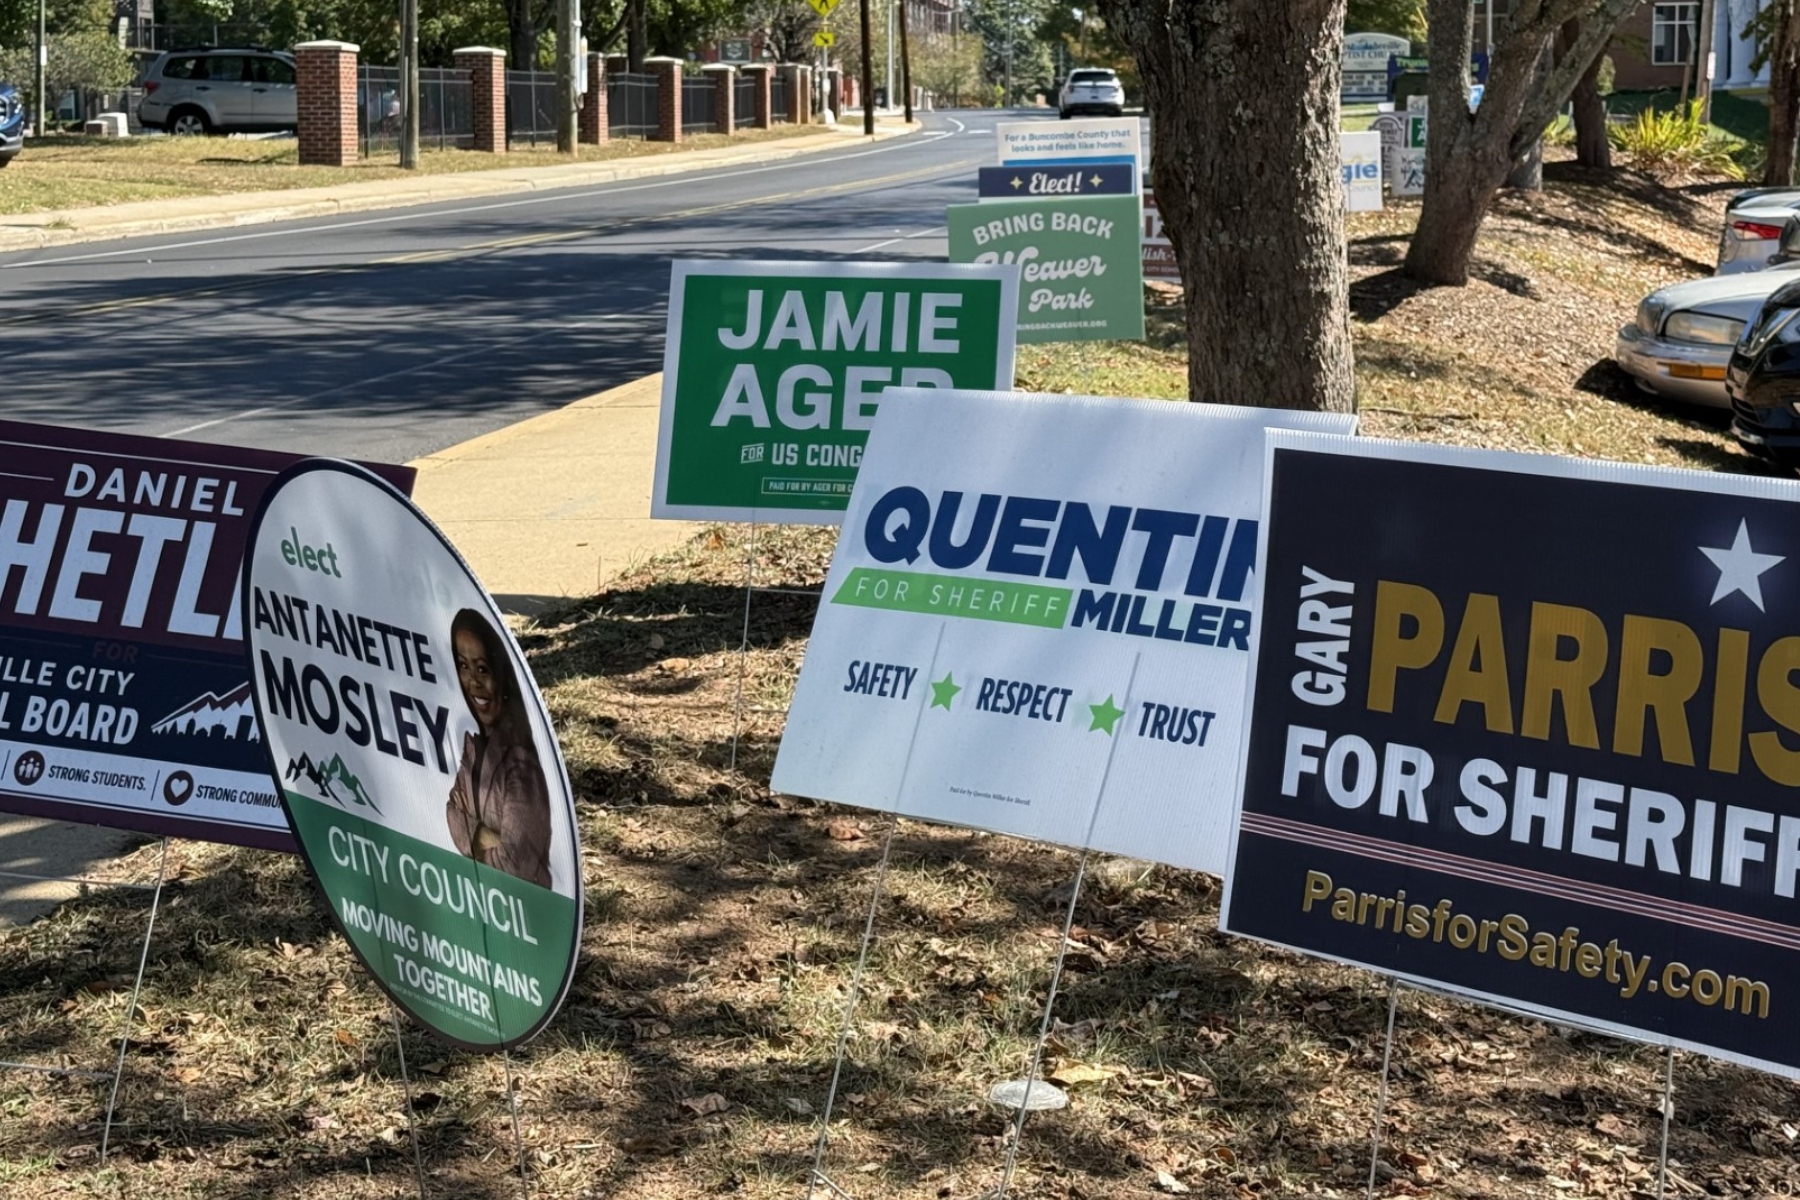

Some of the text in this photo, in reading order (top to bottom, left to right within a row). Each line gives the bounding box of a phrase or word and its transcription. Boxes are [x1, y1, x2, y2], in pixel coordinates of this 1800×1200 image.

[1005, 133, 1019, 142] For
[1028, 132, 1075, 141] Buncombe
[1077, 130, 1109, 140] County
[1111, 129, 1131, 138] that
[1012, 140, 1126, 152] looks and feels like home.
[1028, 171, 1083, 194] Elect!
[972, 212, 1114, 246] BRING BACK
[718, 289, 963, 353] JAMIE
[1028, 287, 1095, 313] Park
[741, 445, 764, 461] FOR
[771, 443, 799, 465] US
[64, 462, 245, 517] DANIEL
[786, 482, 800, 491] FOR
[801, 482, 811, 491] BY
[813, 483, 831, 492] AGER
[833, 483, 846, 492] FOR
[0, 499, 244, 641] HETL
[280, 526, 342, 578] elect
[855, 576, 1062, 619] FOR SHERIFF
[1070, 588, 1252, 651] MILLER
[91, 642, 139, 663] FOR
[254, 585, 438, 685] ANTANETTE
[1291, 565, 1356, 708] GARY
[65, 665, 135, 696] CITY
[843, 660, 1216, 747] SAFETY RESPECT TRUST
[21, 697, 140, 746] BOARD
[260, 648, 451, 776] MOSLEY
[48, 764, 147, 792] STRONG STUDENTS.
[196, 784, 238, 803] STRONG
[1281, 724, 1435, 825] FOR
[328, 825, 539, 946] CITY COUNCIL
[341, 897, 543, 1008] MOVING MOUNTAINS
[1302, 869, 1772, 1020] ParrisforSafety.com
[393, 953, 495, 1023] TOGETHER
